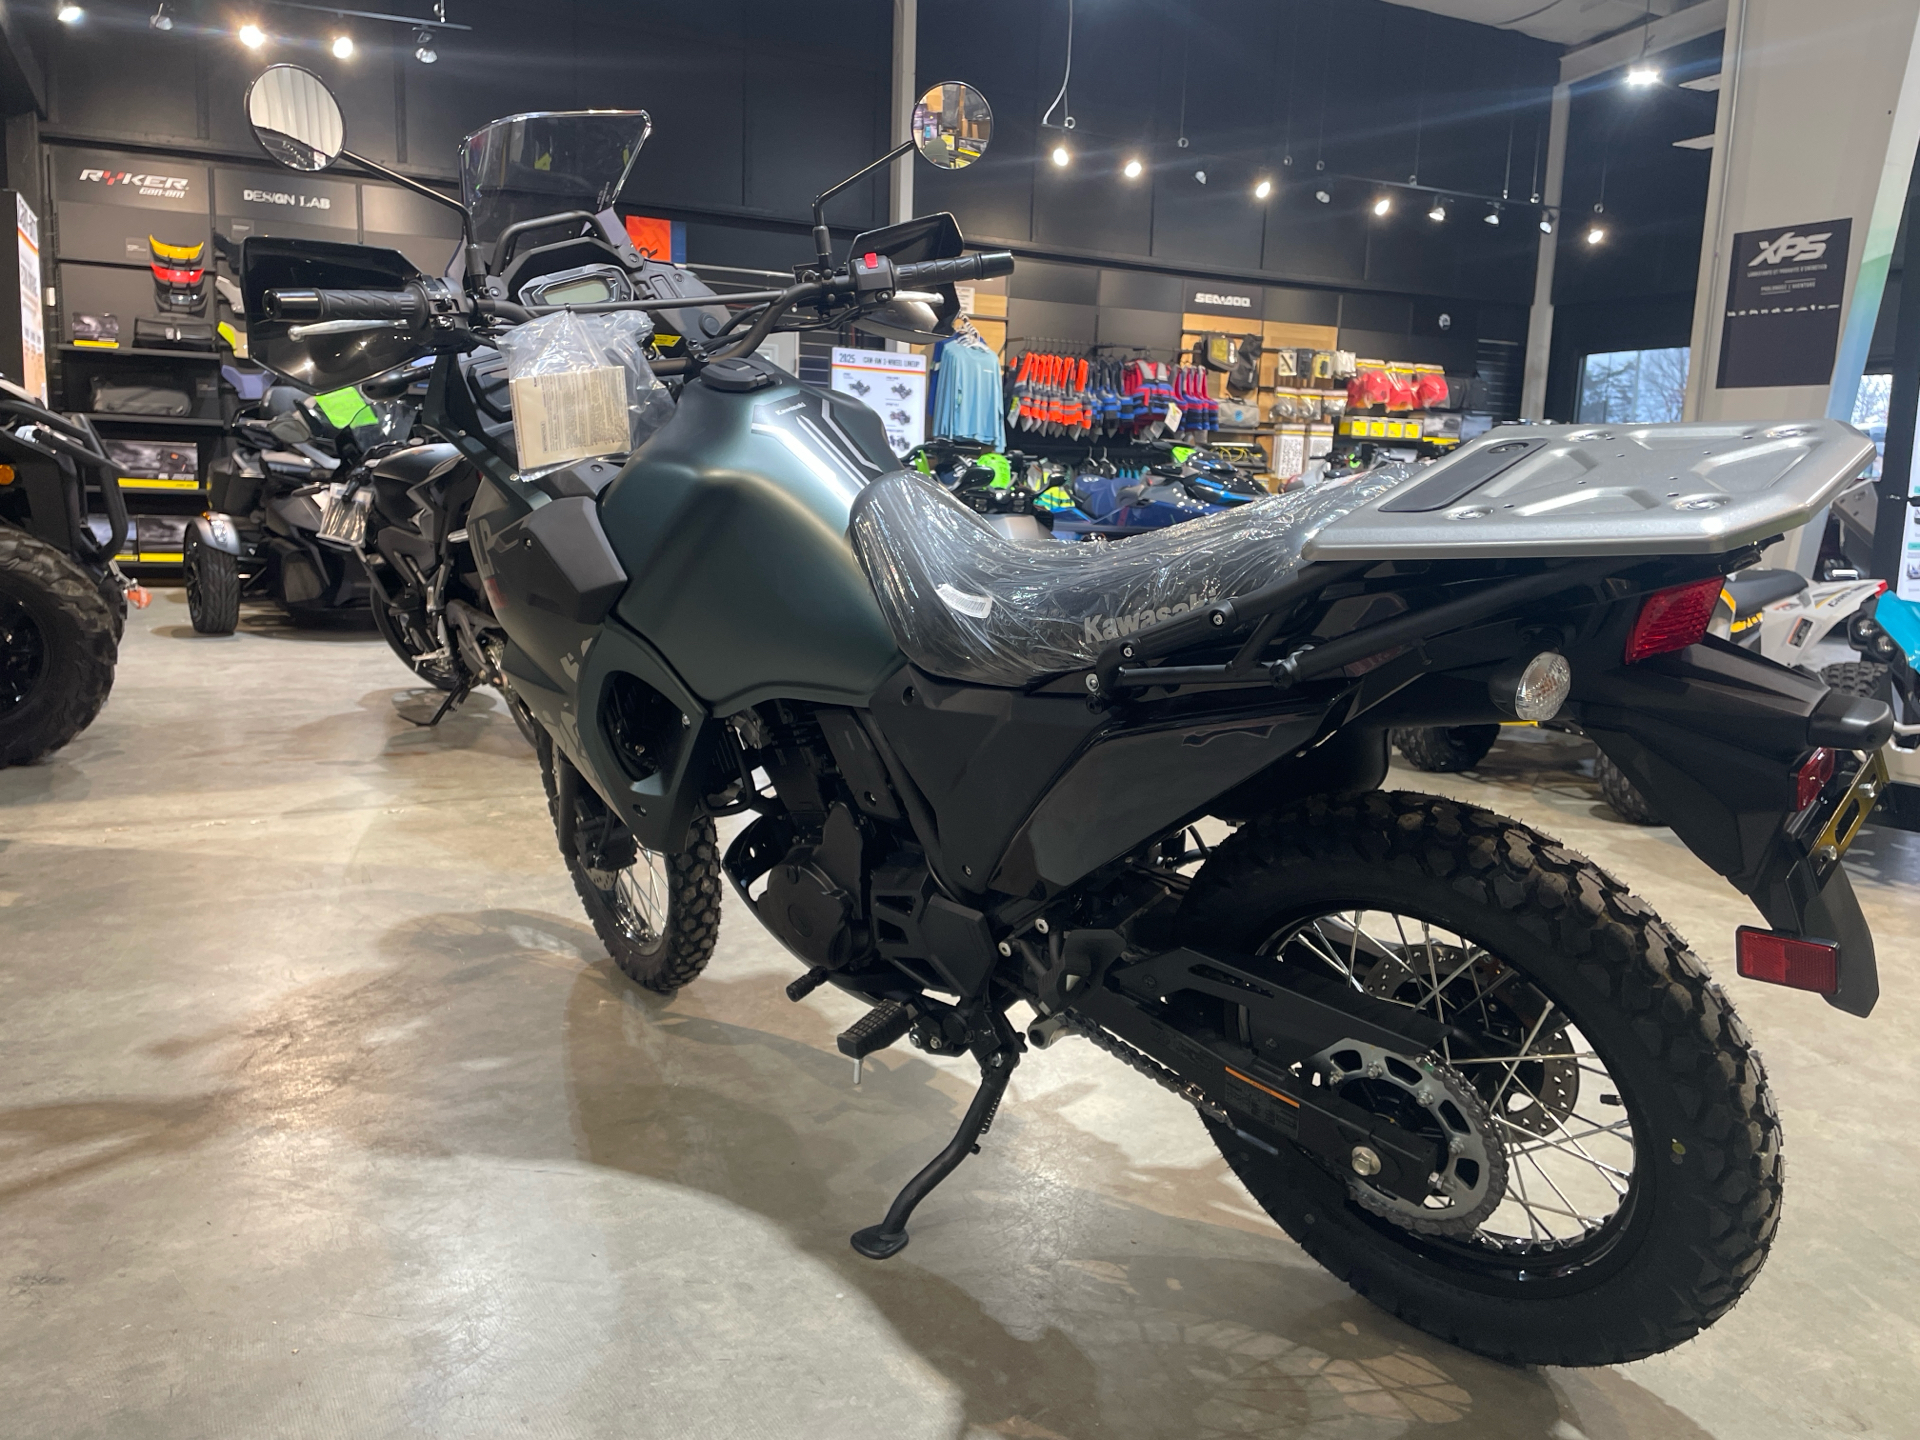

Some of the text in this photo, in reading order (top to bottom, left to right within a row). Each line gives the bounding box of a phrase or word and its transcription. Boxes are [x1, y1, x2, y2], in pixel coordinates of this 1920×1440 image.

[79, 169, 188, 190] RYKER
[243, 189, 331, 210] DESIGN LAB
[1748, 231, 1832, 267] XPS
[839, 353, 856, 364] 2025
